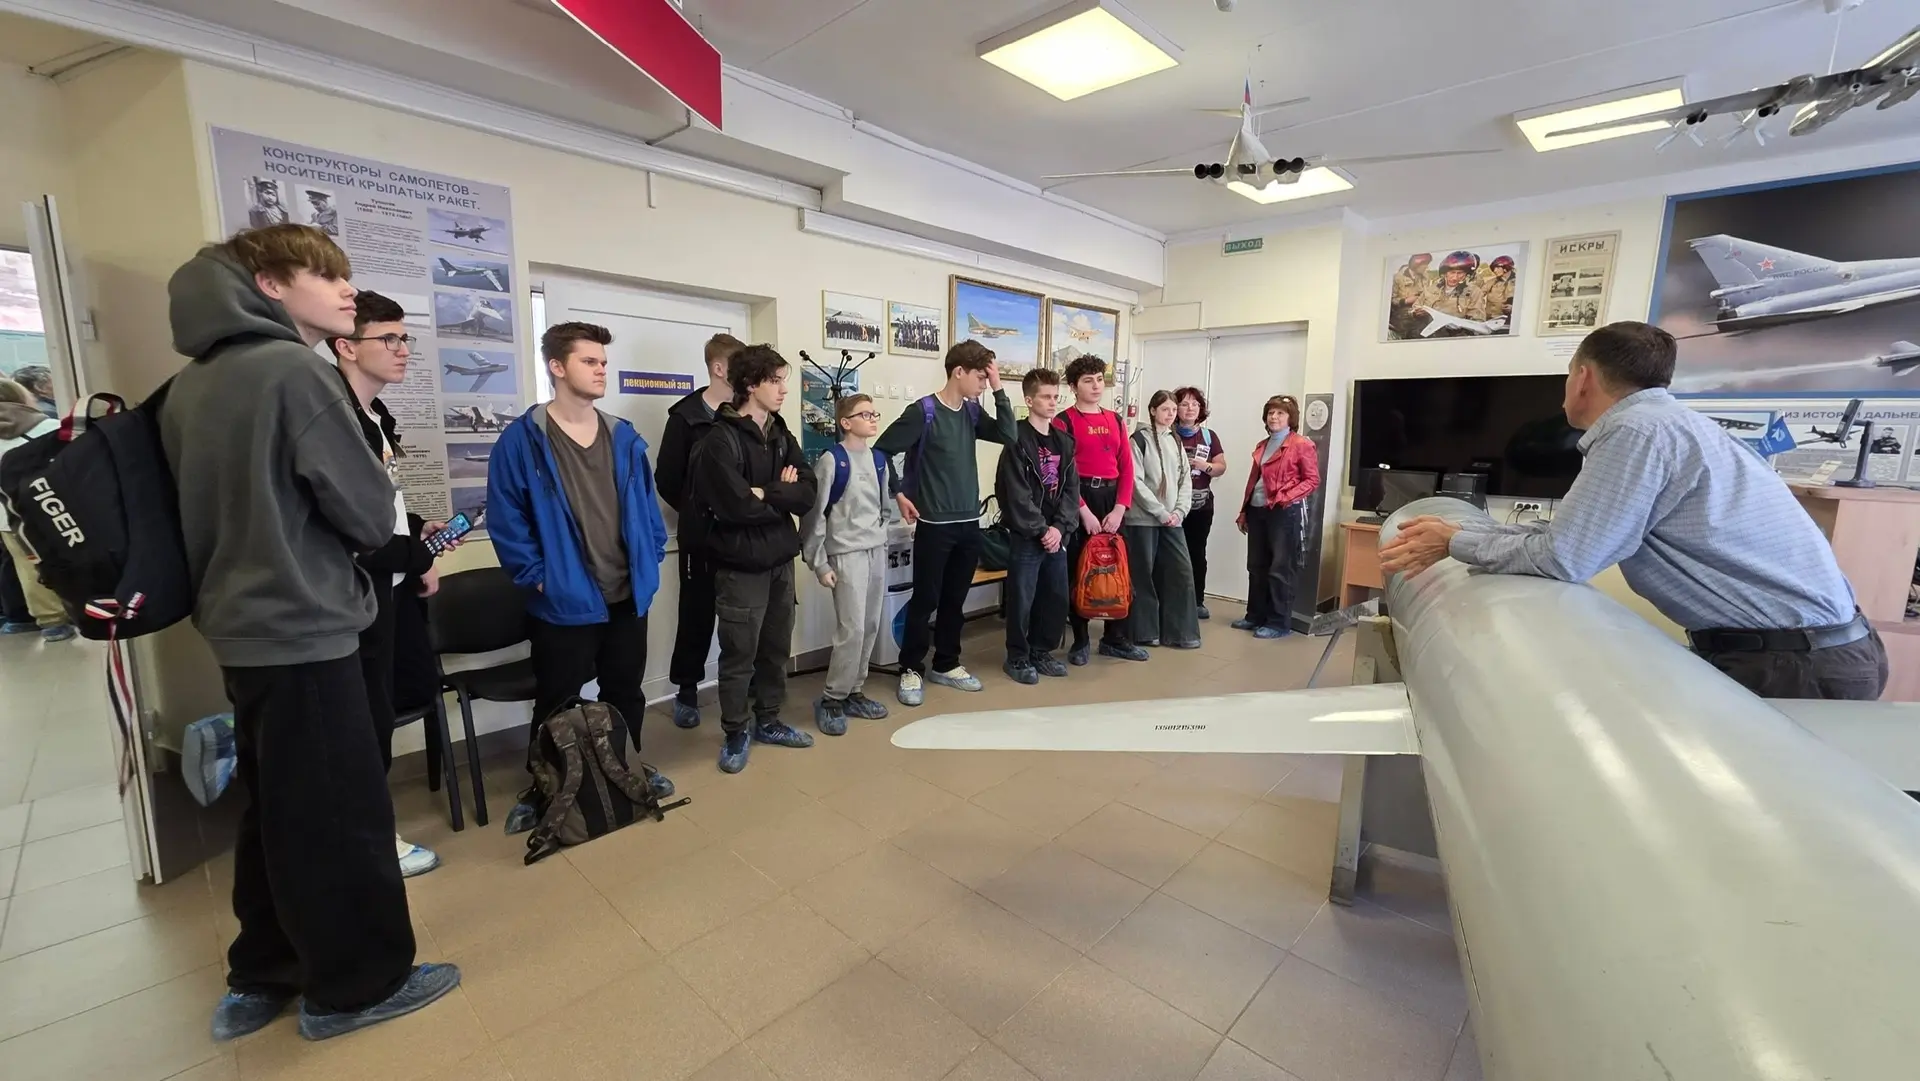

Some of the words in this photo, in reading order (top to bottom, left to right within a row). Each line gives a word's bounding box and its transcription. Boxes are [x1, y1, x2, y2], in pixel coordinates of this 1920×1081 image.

[263, 146, 382, 178] КОНСТРУКТОРЫ
[389, 171, 470, 197] САМОЛЕТОВ
[264, 160, 356, 188] НОСИТЕЛЕЙ
[358, 180, 435, 203] КРЫЛАТЫХ
[438, 195, 481, 211] РАКЕТ.
[1226, 240, 1262, 251] ВЫХОД
[1560, 241, 1605, 253] ИСКРЫ
[623, 378, 675, 389] лекционный
[677, 381, 691, 390] зал
[1784, 411, 1800, 419] ИЗ
[1802, 411, 1861, 419] ИСТОР
[1863, 411, 1920, 420] ДАЛЬНЕ
[29, 477, 86, 549] FIGER
